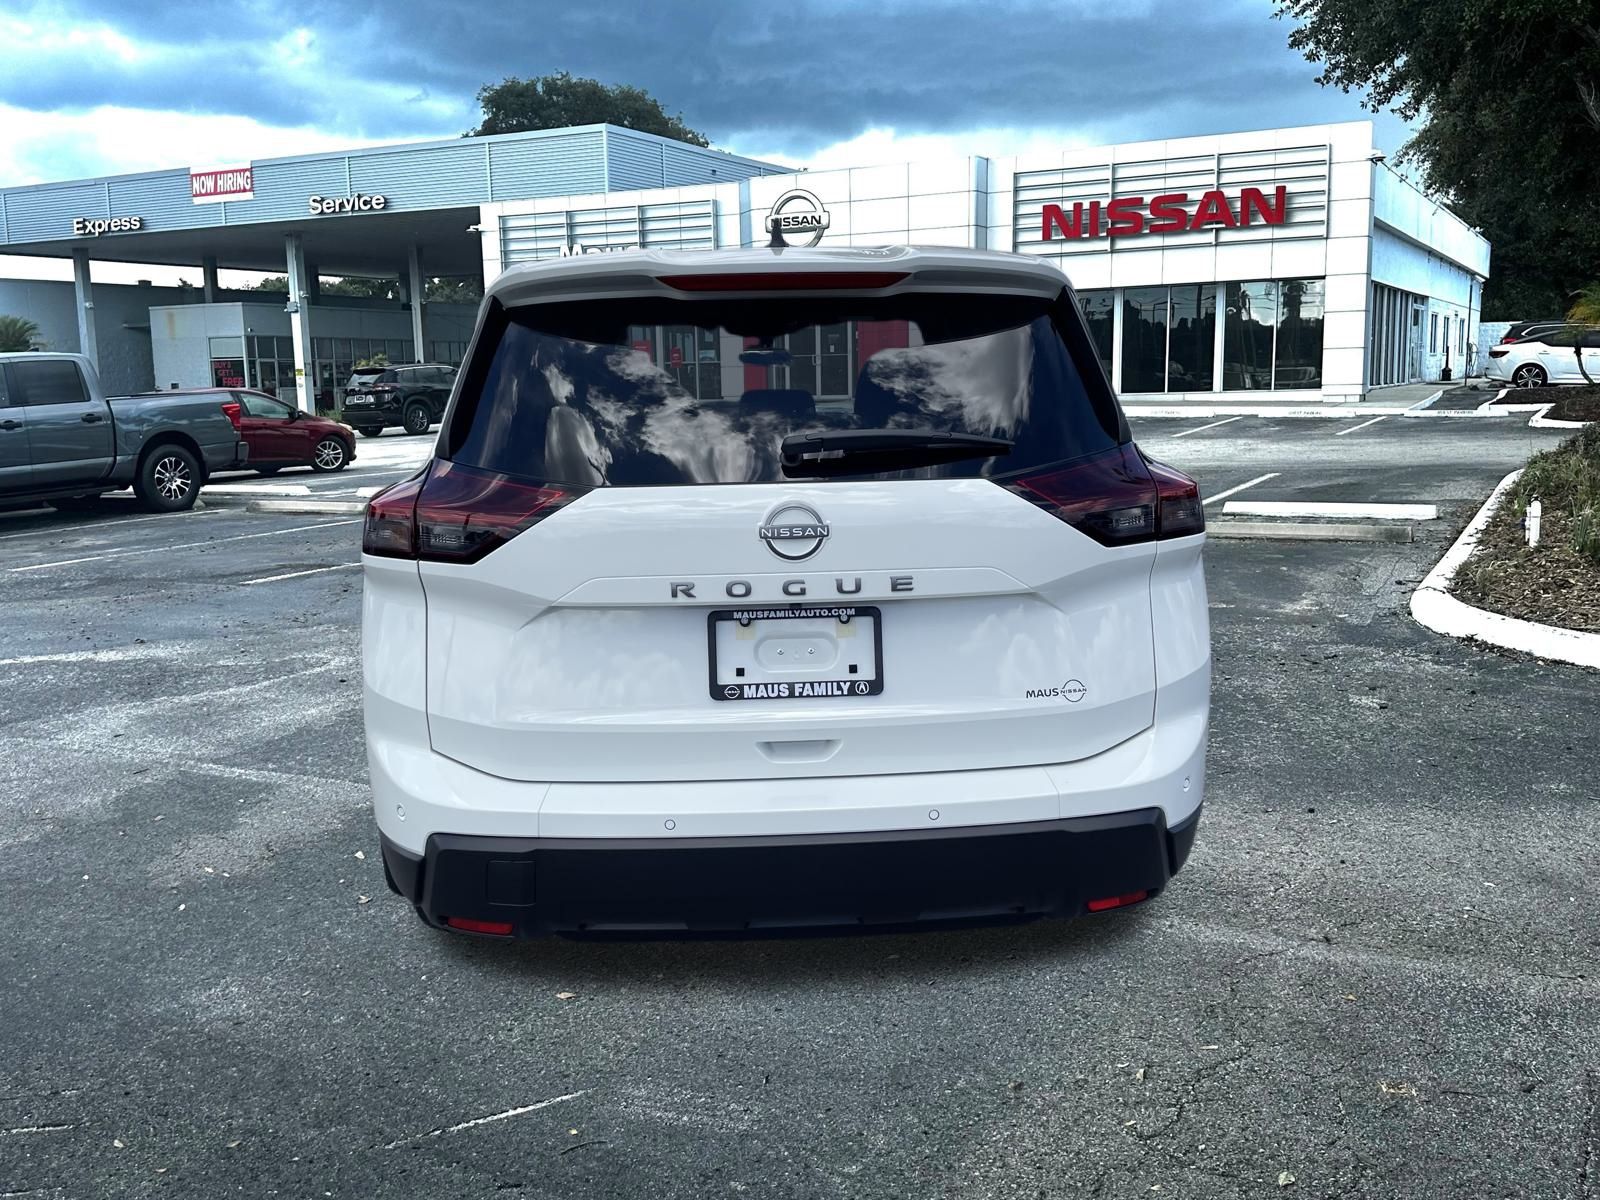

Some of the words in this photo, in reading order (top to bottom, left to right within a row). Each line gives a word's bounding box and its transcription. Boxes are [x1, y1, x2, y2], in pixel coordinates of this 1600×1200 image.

[192, 174, 215, 195] NOW
[217, 171, 251, 192] HIRING
[309, 193, 385, 215] Service
[1042, 185, 1287, 241] NISSAN
[73, 216, 141, 237] Express
[223, 377, 244, 387] FREE
[761, 526, 828, 538] NISSAN
[670, 575, 914, 598] ROGUE
[733, 608, 856, 619] MAUSFAMILYAUTO.COM
[743, 683, 789, 698] MAUS
[794, 681, 851, 696] FAMILY
[1026, 687, 1060, 699] MAUS
